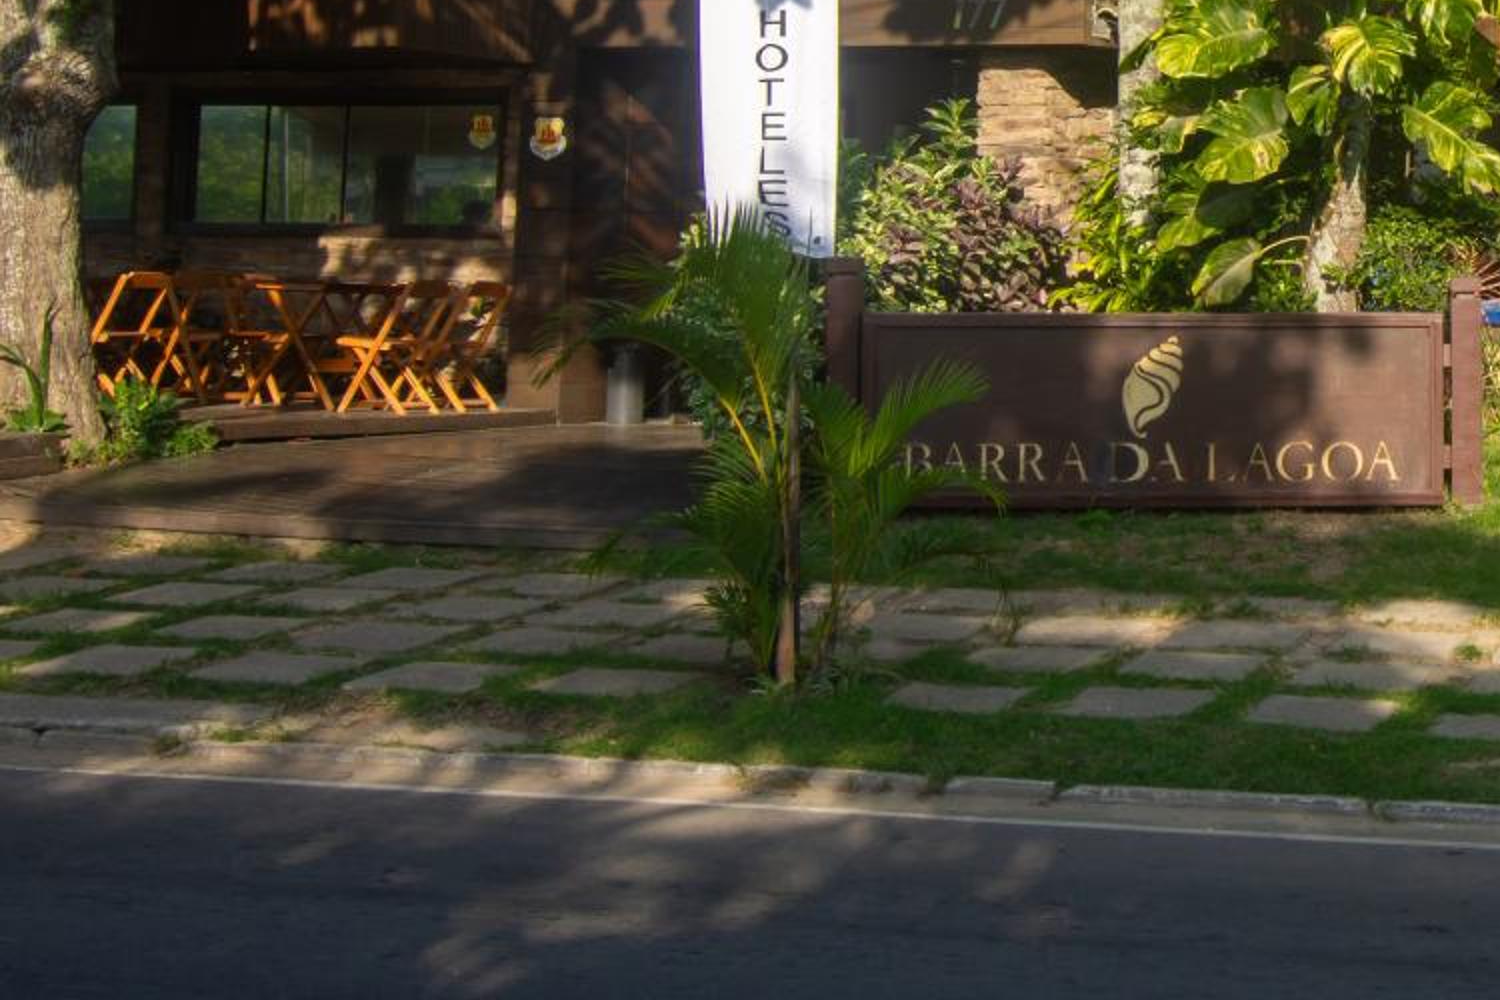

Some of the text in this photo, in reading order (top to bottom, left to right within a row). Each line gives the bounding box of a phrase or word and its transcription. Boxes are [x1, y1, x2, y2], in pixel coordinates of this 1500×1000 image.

[902, 440, 1401, 483] BARRA DA LAGOA
